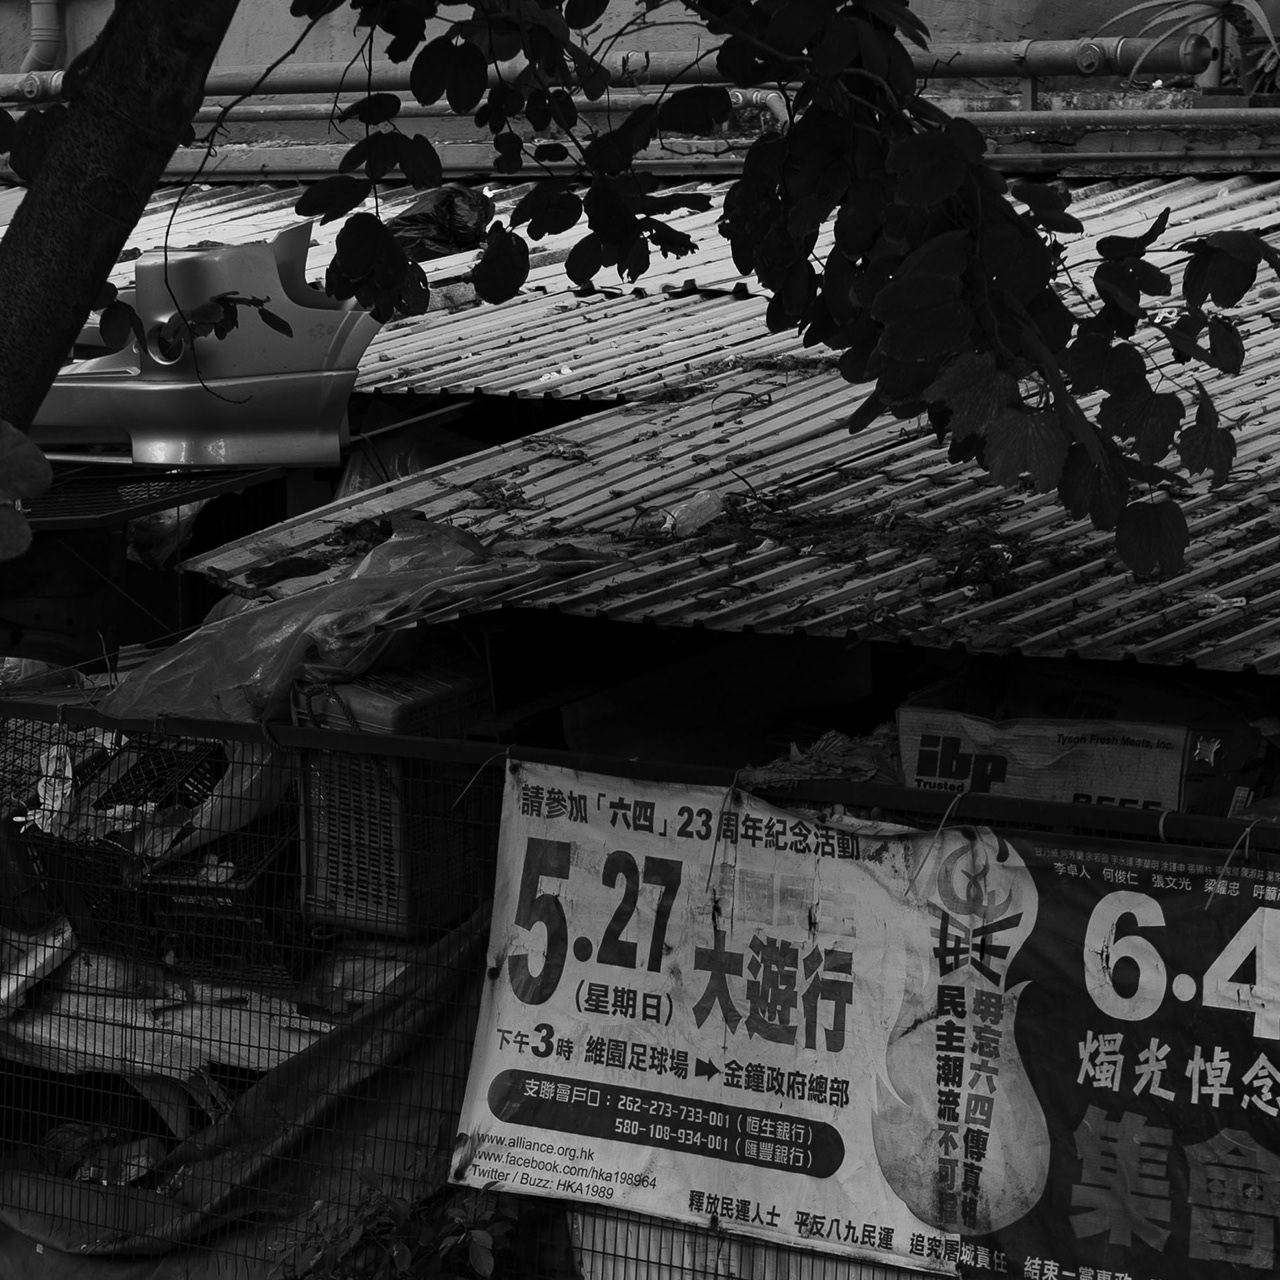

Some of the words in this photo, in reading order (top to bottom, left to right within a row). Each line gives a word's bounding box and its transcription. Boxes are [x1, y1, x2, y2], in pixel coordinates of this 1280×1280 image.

[916, 734, 1008, 793] ibp
[1057, 734, 1086, 745] Tyson
[1089, 735, 1117, 745] Fresh
[1120, 737, 1153, 749] Meats,
[1156, 739, 1174, 750] Inc.
[915, 778, 965, 792] Trusted
[1053, 862, 1091, 880] 李卓人
[1102, 867, 1139, 886] 何俊仁
[1151, 873, 1192, 891] 張文光
[507, 836, 684, 1006] 5.27
[575, 979, 674, 1027] (星期日)
[691, 929, 854, 1053] 大遊行
[496, 1022, 574, 1062] 下午3時
[584, 1035, 690, 1080] 維園足球場
[723, 1060, 851, 1108] 金鐘政府總部
[477, 1132, 595, 1161] www.alliance.org.hk
[472, 1163, 511, 1182] Twitter
[520, 1172, 554, 1190] Buzz:
[556, 1178, 614, 1200] HKA1989
[475, 1150, 658, 1189] www.facebook.com/hka198964
[689, 1189, 781, 1228] 釋放民運人士
[794, 1210, 895, 1251] 平反八九民運
[909, 1232, 1008, 1274] 追究屠城責任
